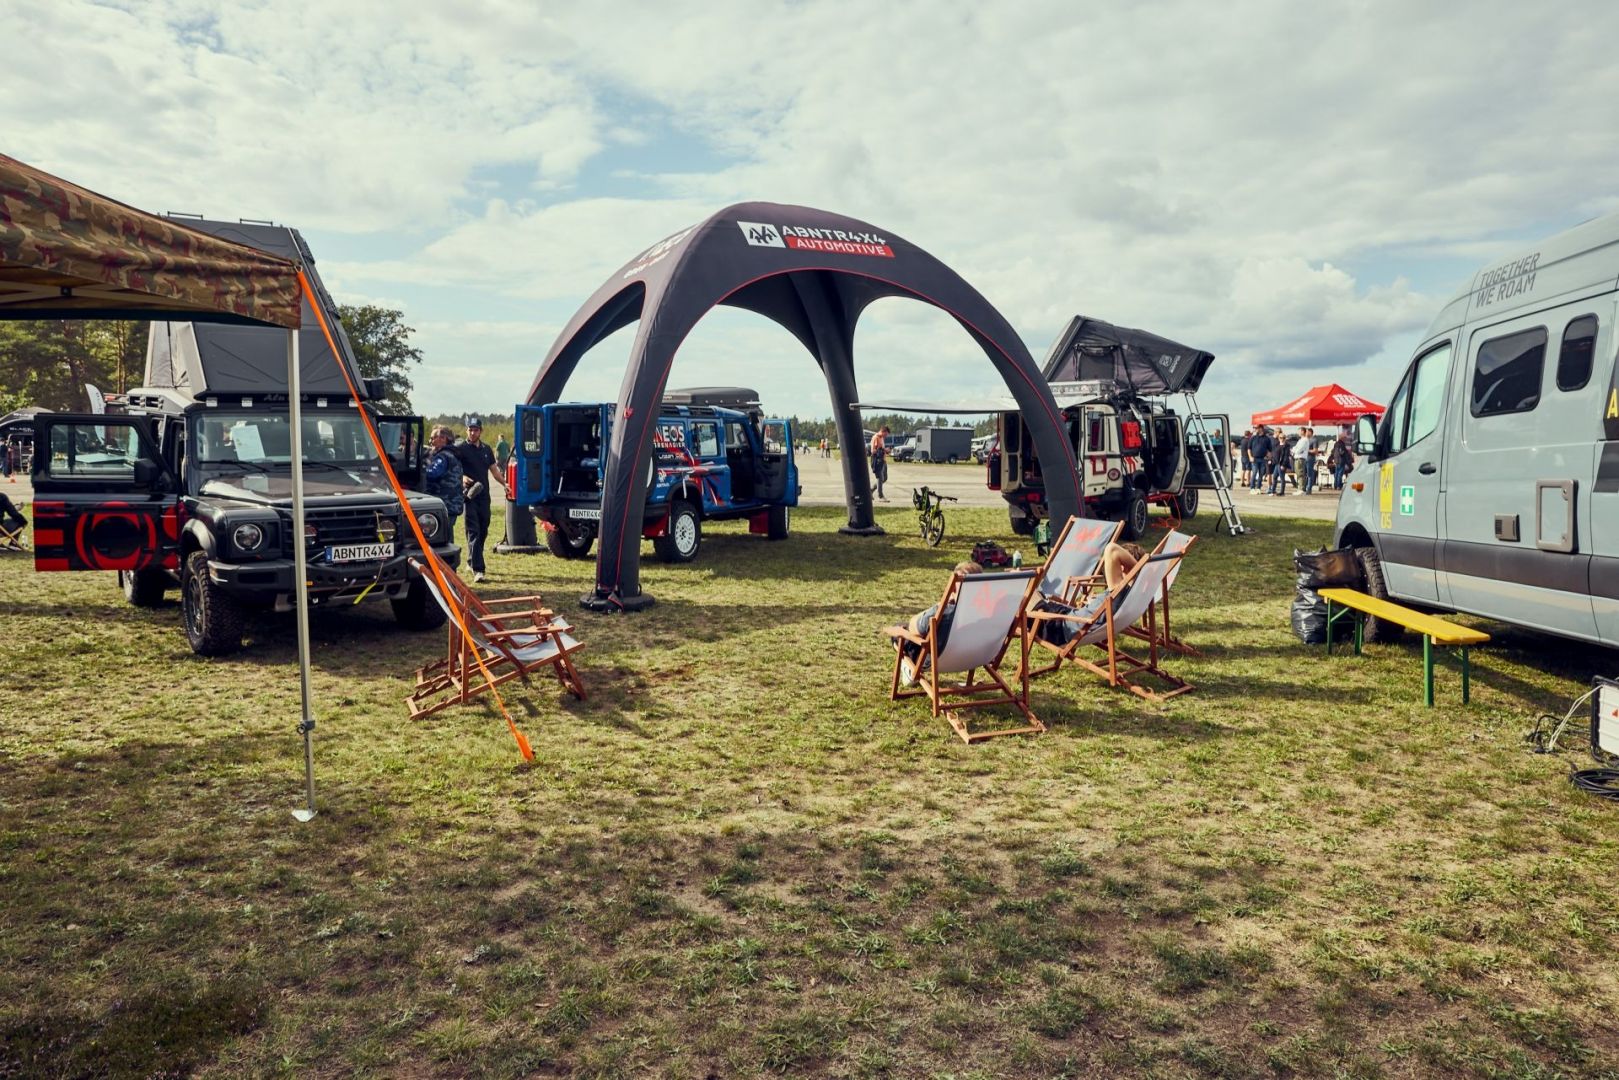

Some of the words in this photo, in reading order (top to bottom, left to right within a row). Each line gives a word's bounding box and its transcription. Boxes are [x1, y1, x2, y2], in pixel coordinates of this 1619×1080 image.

[782, 225, 886, 245] ABNTR4X4
[796, 238, 886, 256] AUTOMOTIVE
[1480, 252, 1540, 289] TOGETHER
[1476, 287, 1495, 308] WE
[1497, 272, 1536, 301] ROAM
[652, 425, 685, 443] NEOS
[333, 545, 391, 560] ABNTR4X4
